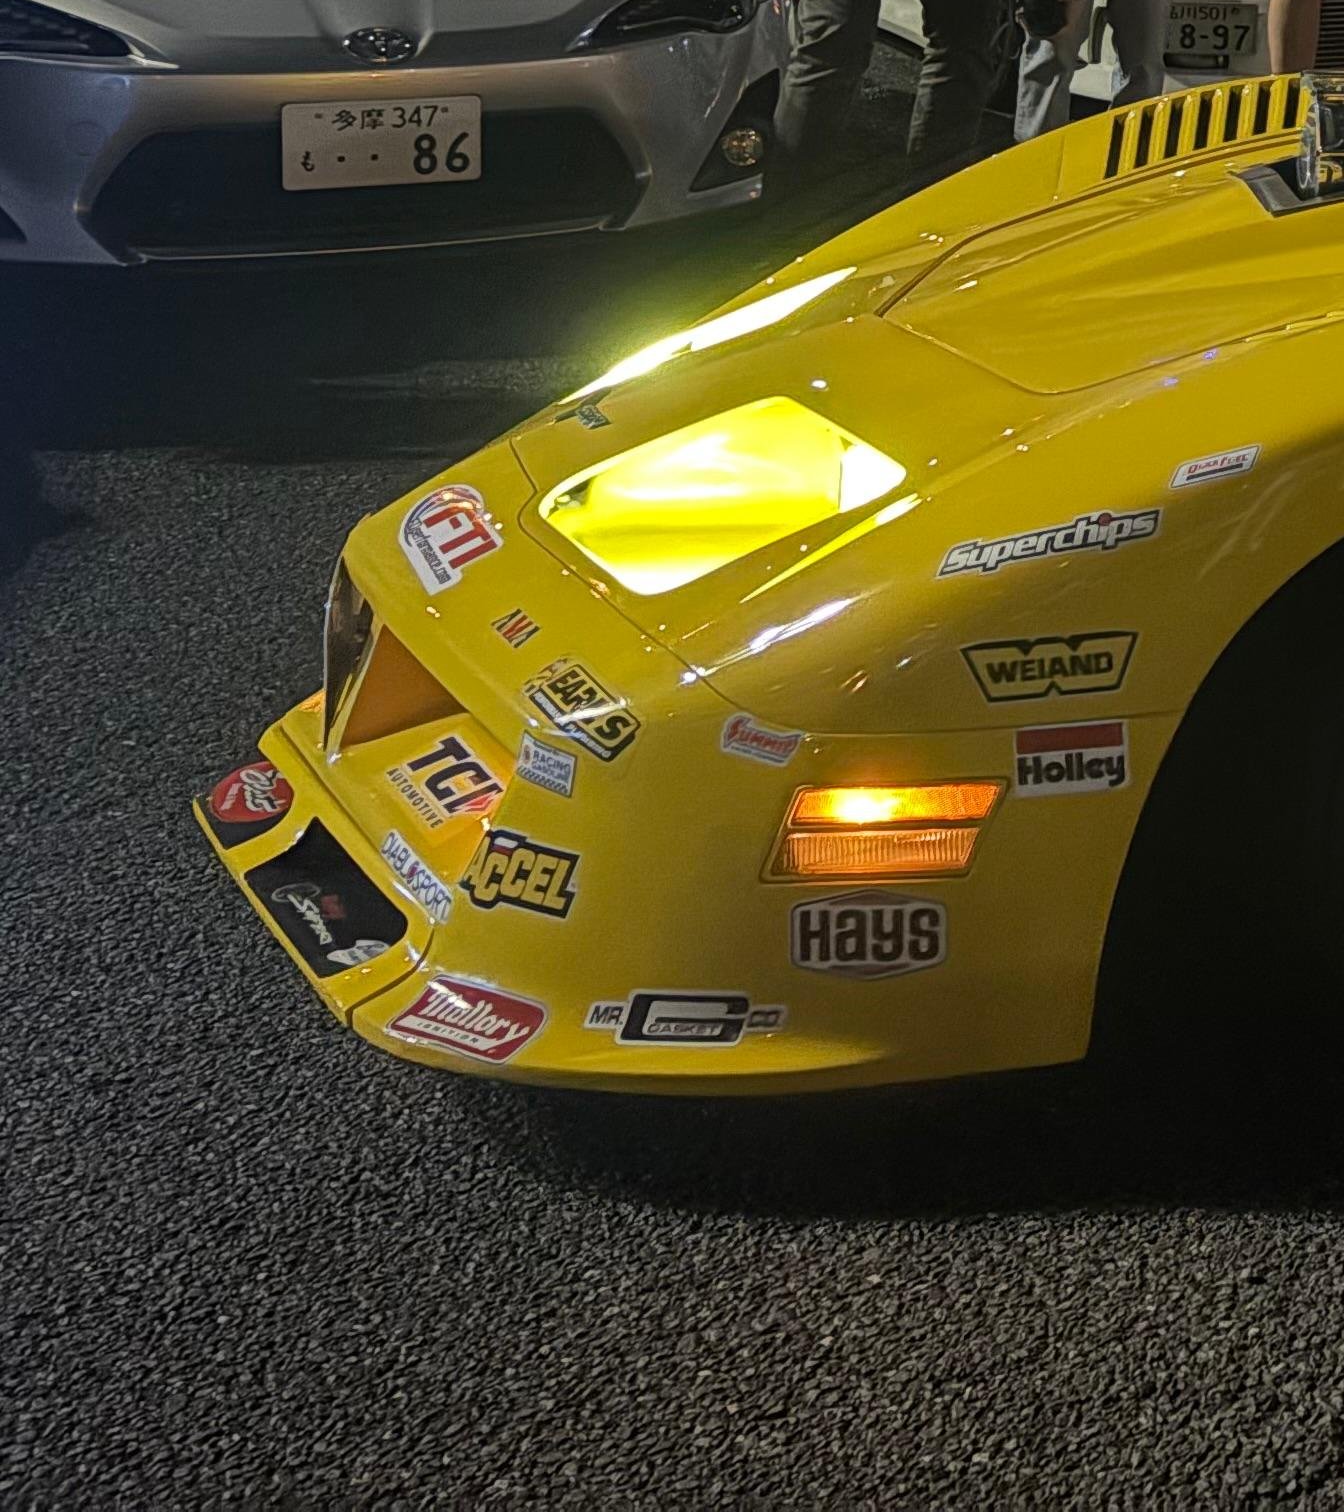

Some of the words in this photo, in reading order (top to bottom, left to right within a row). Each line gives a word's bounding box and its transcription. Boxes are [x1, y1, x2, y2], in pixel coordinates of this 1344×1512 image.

[1178, 23, 1251, 51] 8-97
[332, 109, 385, 131] 多摩
[392, 105, 439, 129] 347
[422, 505, 498, 570] FTI
[942, 509, 1159, 574] Superchips
[986, 650, 1114, 684] WEIAND
[386, 768, 444, 829] AUTOMOTIVE
[407, 736, 504, 814] TCI
[1017, 751, 1126, 788] Holley
[464, 837, 571, 910] ACCEL
[416, 1022, 480, 1045] IGNITION
[418, 985, 530, 1044] Mallory
